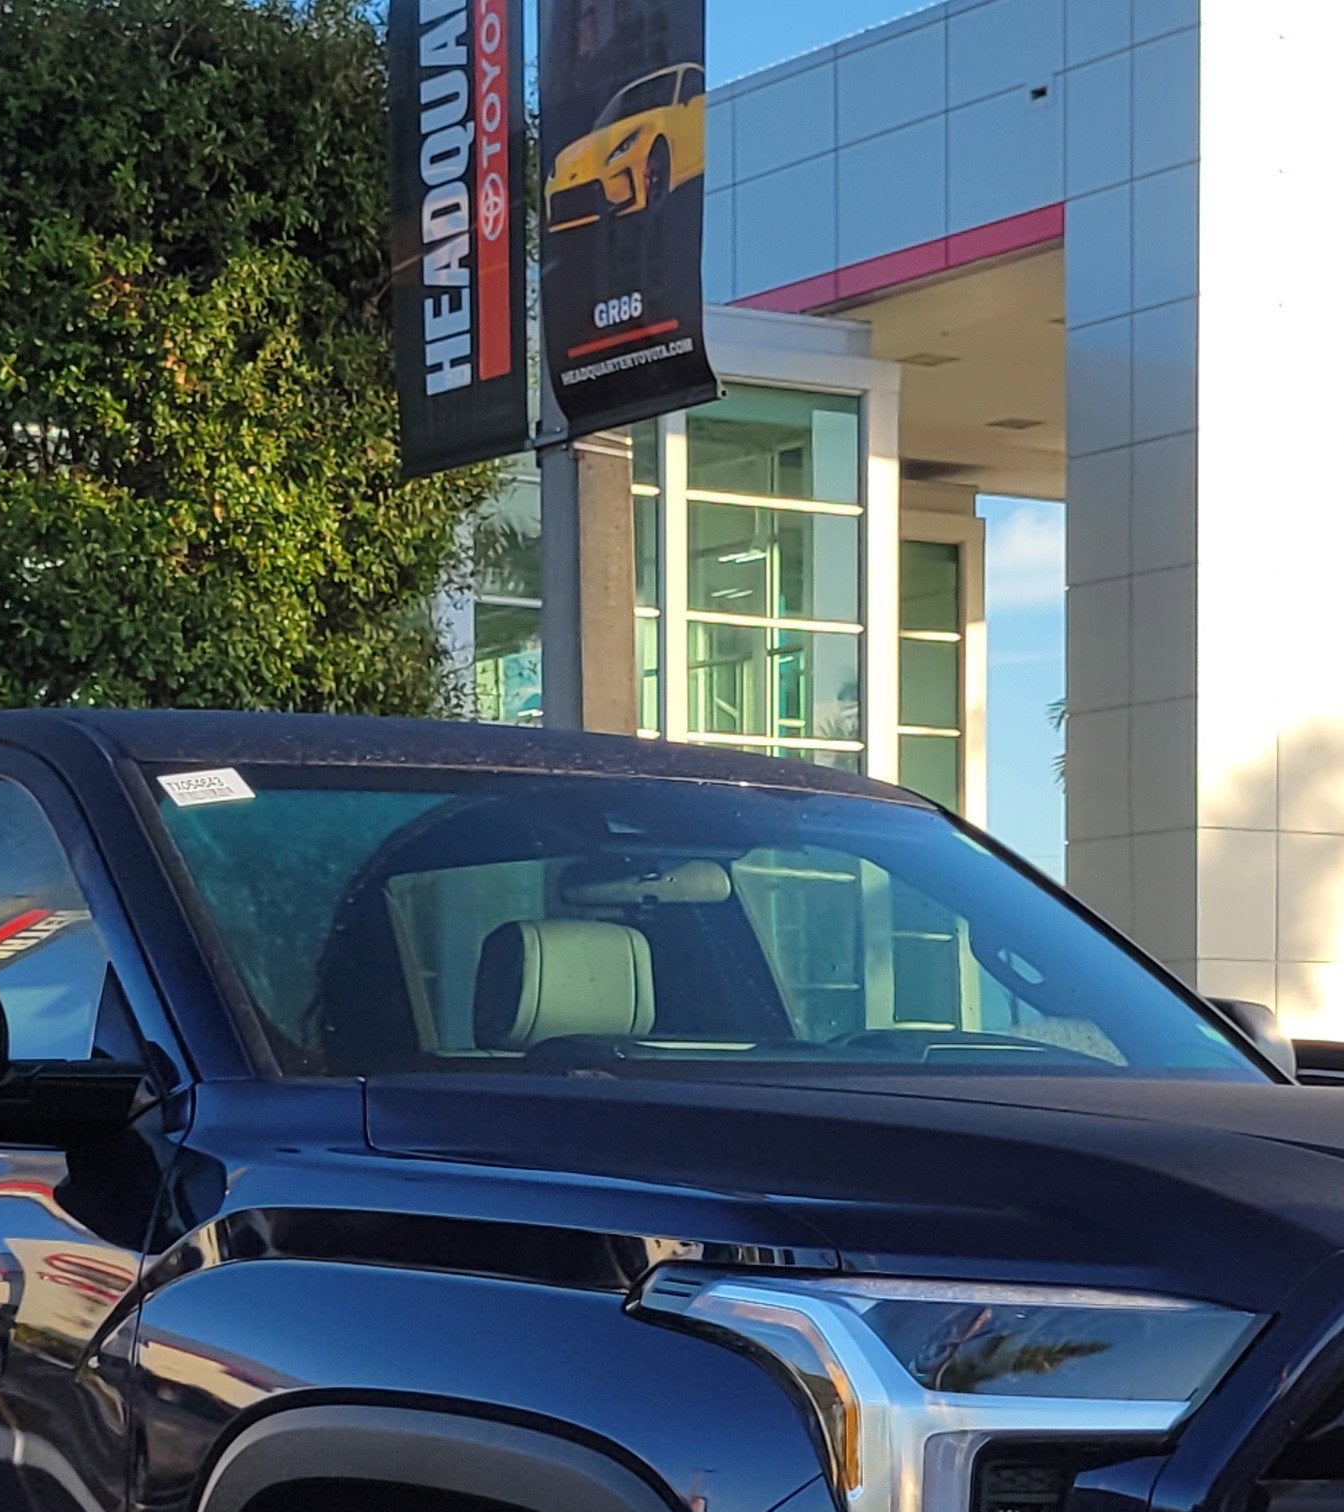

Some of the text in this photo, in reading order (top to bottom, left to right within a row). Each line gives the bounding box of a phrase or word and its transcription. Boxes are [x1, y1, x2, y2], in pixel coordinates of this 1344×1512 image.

[477, 0, 503, 166] TOYO
[419, 0, 474, 397] HEADQUA
[561, 338, 694, 386] HEADQUARTERTOYOTA.COM
[594, 292, 642, 329] GR86
